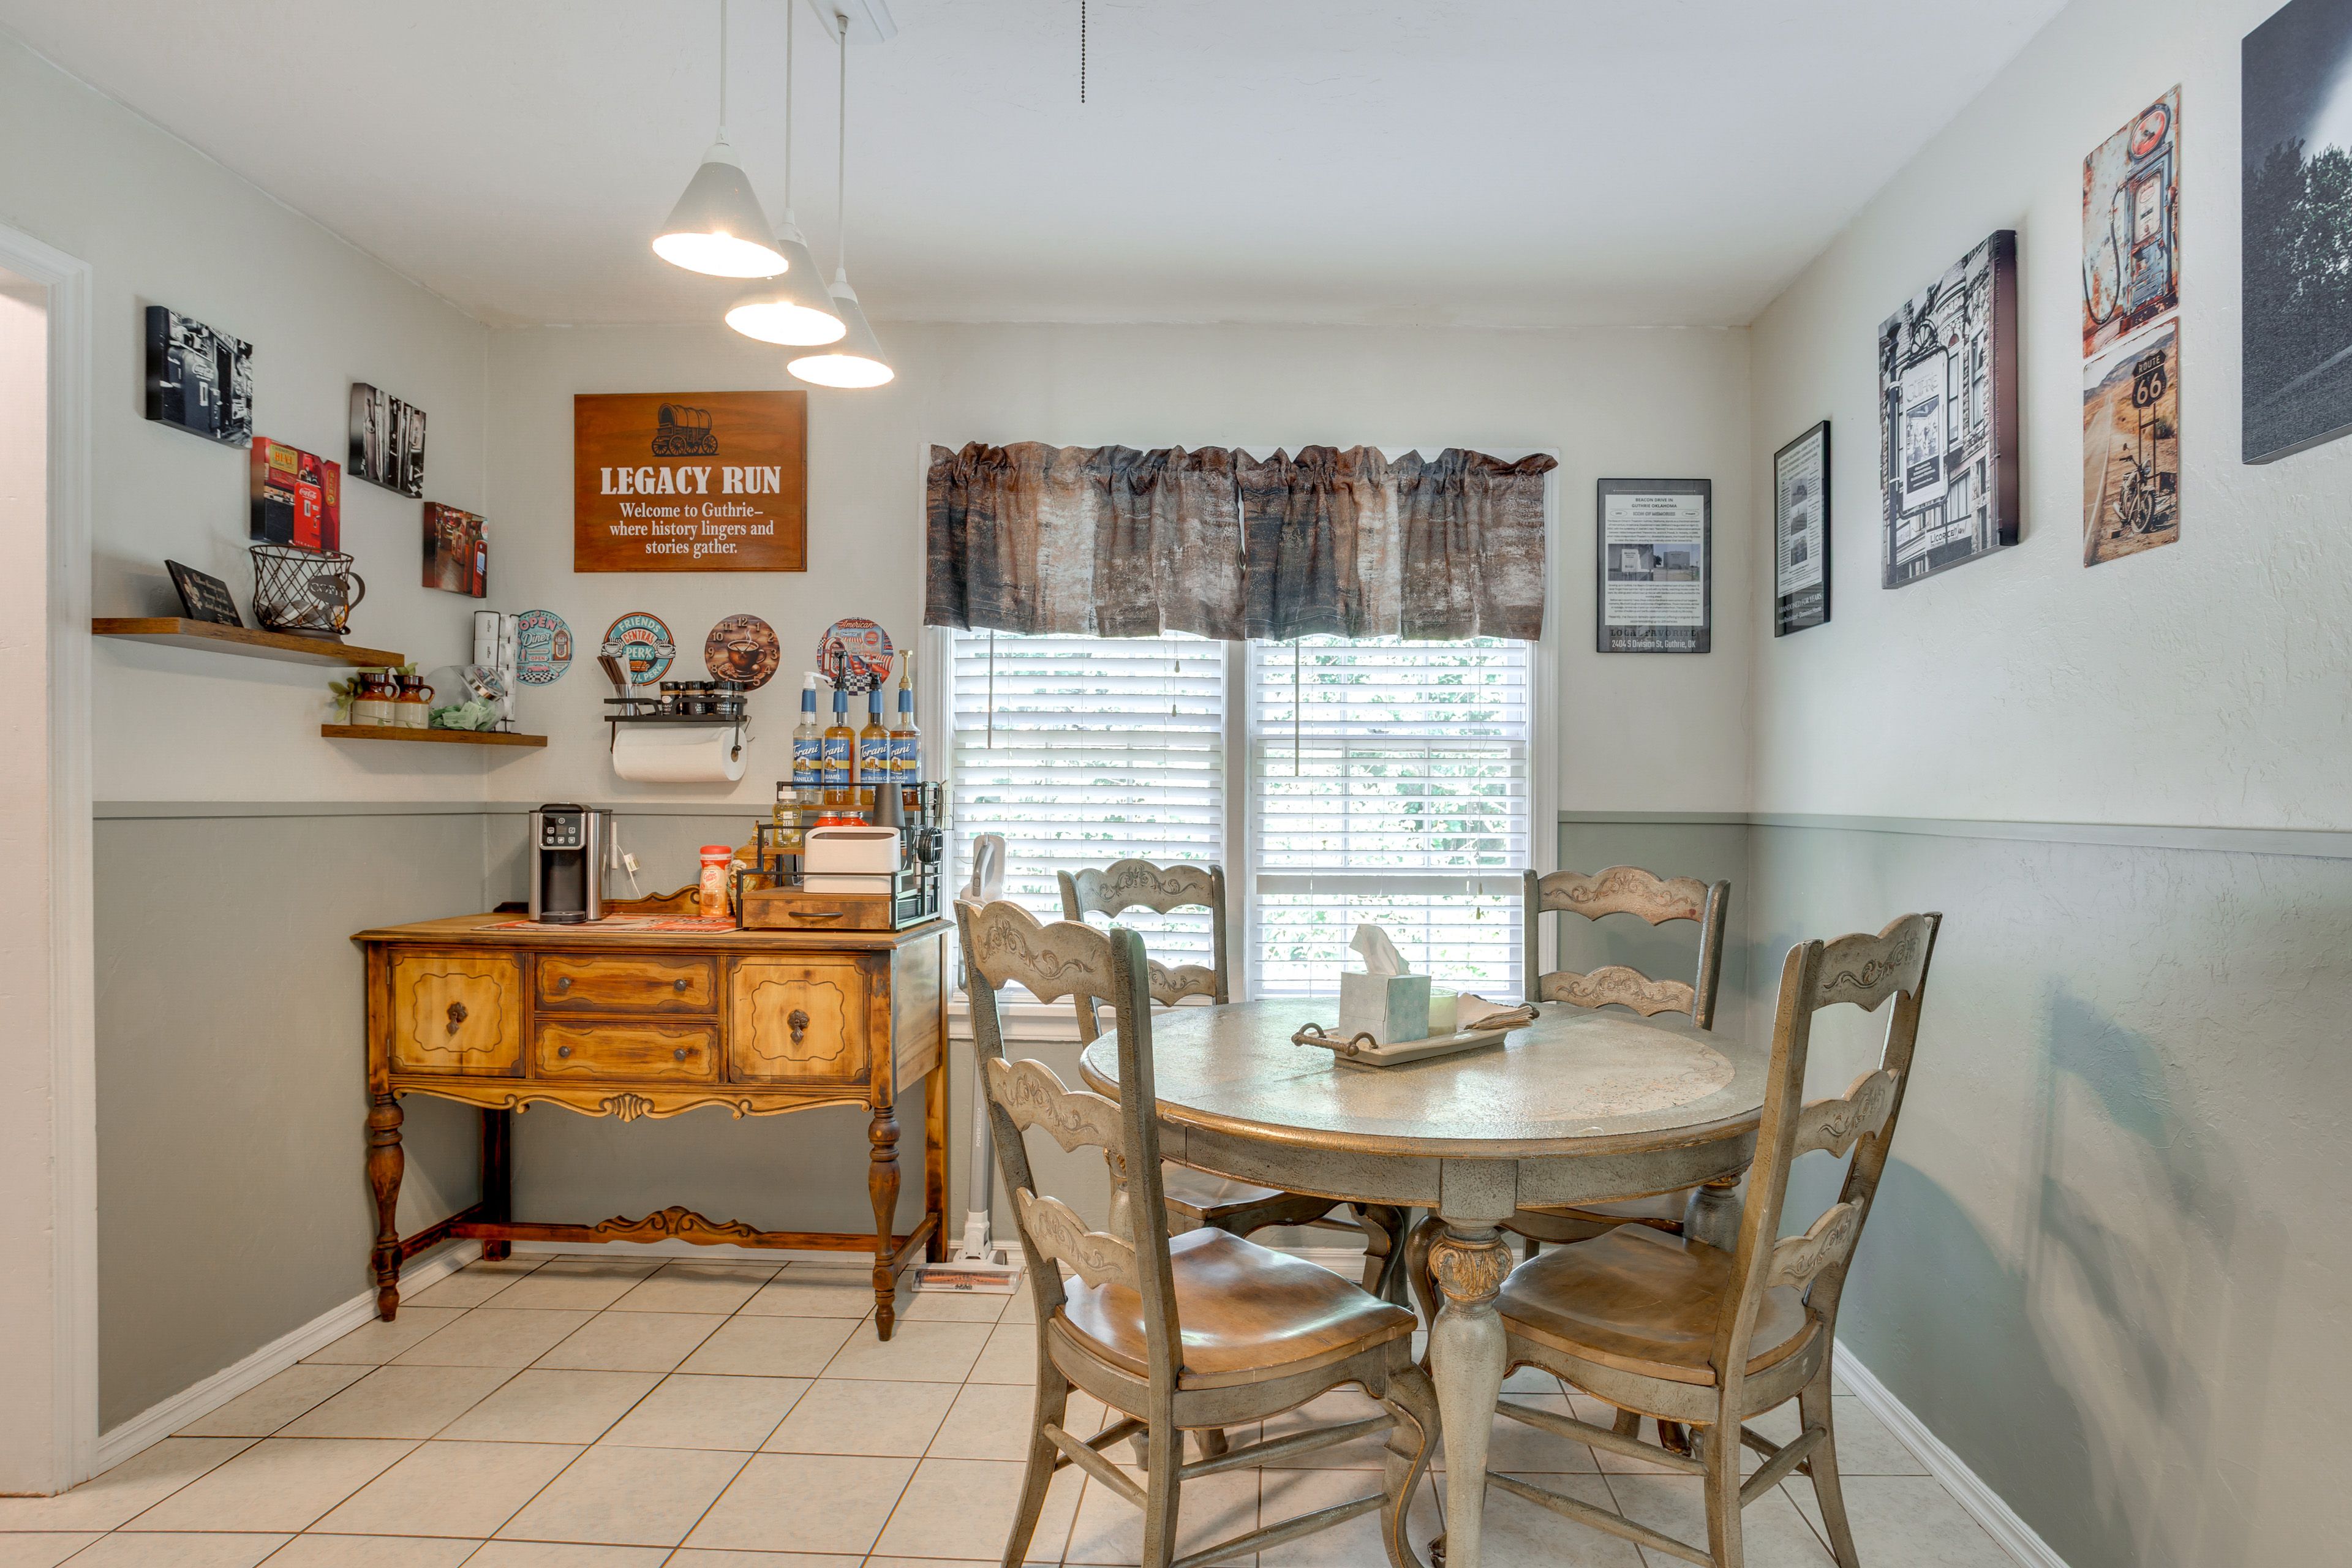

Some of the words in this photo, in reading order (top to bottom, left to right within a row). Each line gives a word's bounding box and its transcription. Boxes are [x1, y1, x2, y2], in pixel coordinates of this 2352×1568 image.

[2138, 355, 2160, 373] ROUTE
[2136, 372, 2162, 404] 66
[600, 466, 712, 495] LEGACY
[722, 466, 782, 494] RUN
[619, 502, 680, 518] Welcome
[684, 503, 698, 518] to
[609, 521, 648, 536] where
[652, 521, 698, 540] history
[701, 521, 747, 540] lingers
[750, 520, 774, 535] and
[1930, 529, 1954, 543] LICORCE
[645, 539, 689, 554] stories
[693, 539, 737, 559] gather.
[519, 617, 557, 631] OPEN
[618, 617, 661, 633] FRIENDS
[723, 622, 733, 631] 11
[737, 617, 748, 627] 12
[756, 622, 760, 631] 1
[837, 620, 874, 630] American
[522, 631, 551, 646] Diner
[712, 632, 724, 641] 10
[767, 631, 774, 643] 2
[1645, 629, 1697, 638] FAVORITE
[1665, 639, 1687, 649] Guthrie,
[627, 647, 653, 658] PERK
[707, 647, 715, 658] 9
[771, 649, 778, 660] 3
[644, 663, 663, 680] PERK
[711, 664, 718, 673] 8
[764, 666, 771, 674] 4
[753, 676, 761, 686] 5
[793, 744, 819, 758] Torani
[824, 744, 845, 756] rani
[860, 743, 887, 760] Torani
[890, 744, 910, 756] rani
